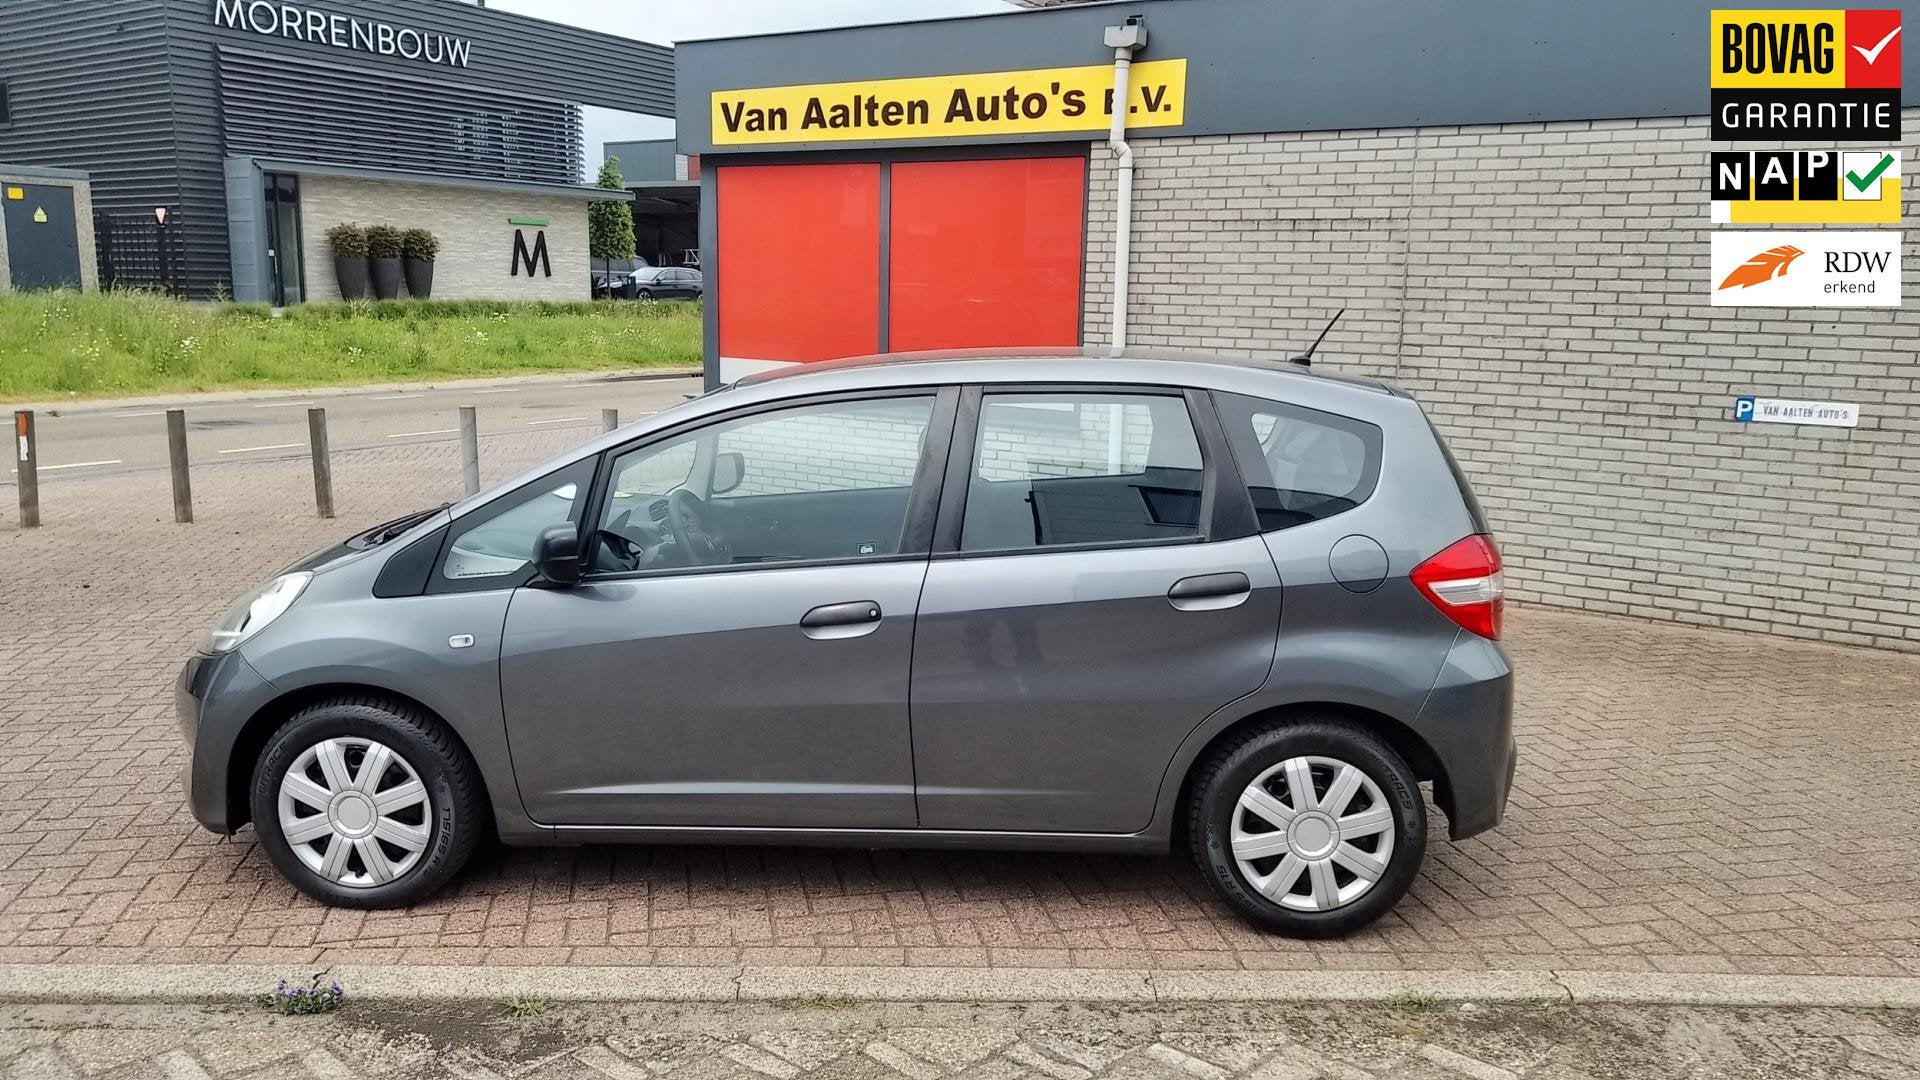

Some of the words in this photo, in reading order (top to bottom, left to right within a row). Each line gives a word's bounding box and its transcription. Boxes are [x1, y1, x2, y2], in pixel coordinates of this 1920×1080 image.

[214, 0, 471, 68] MORRENBOUW
[720, 101, 788, 132] Van
[801, 94, 929, 130] Aalten
[944, 82, 1086, 124] Auto's
[510, 228, 552, 277] M
[1736, 400, 1753, 418] P
[1763, 406, 1779, 416] VAN
[1783, 407, 1814, 418] AALTEN
[1817, 409, 1849, 420] AUTO'S
